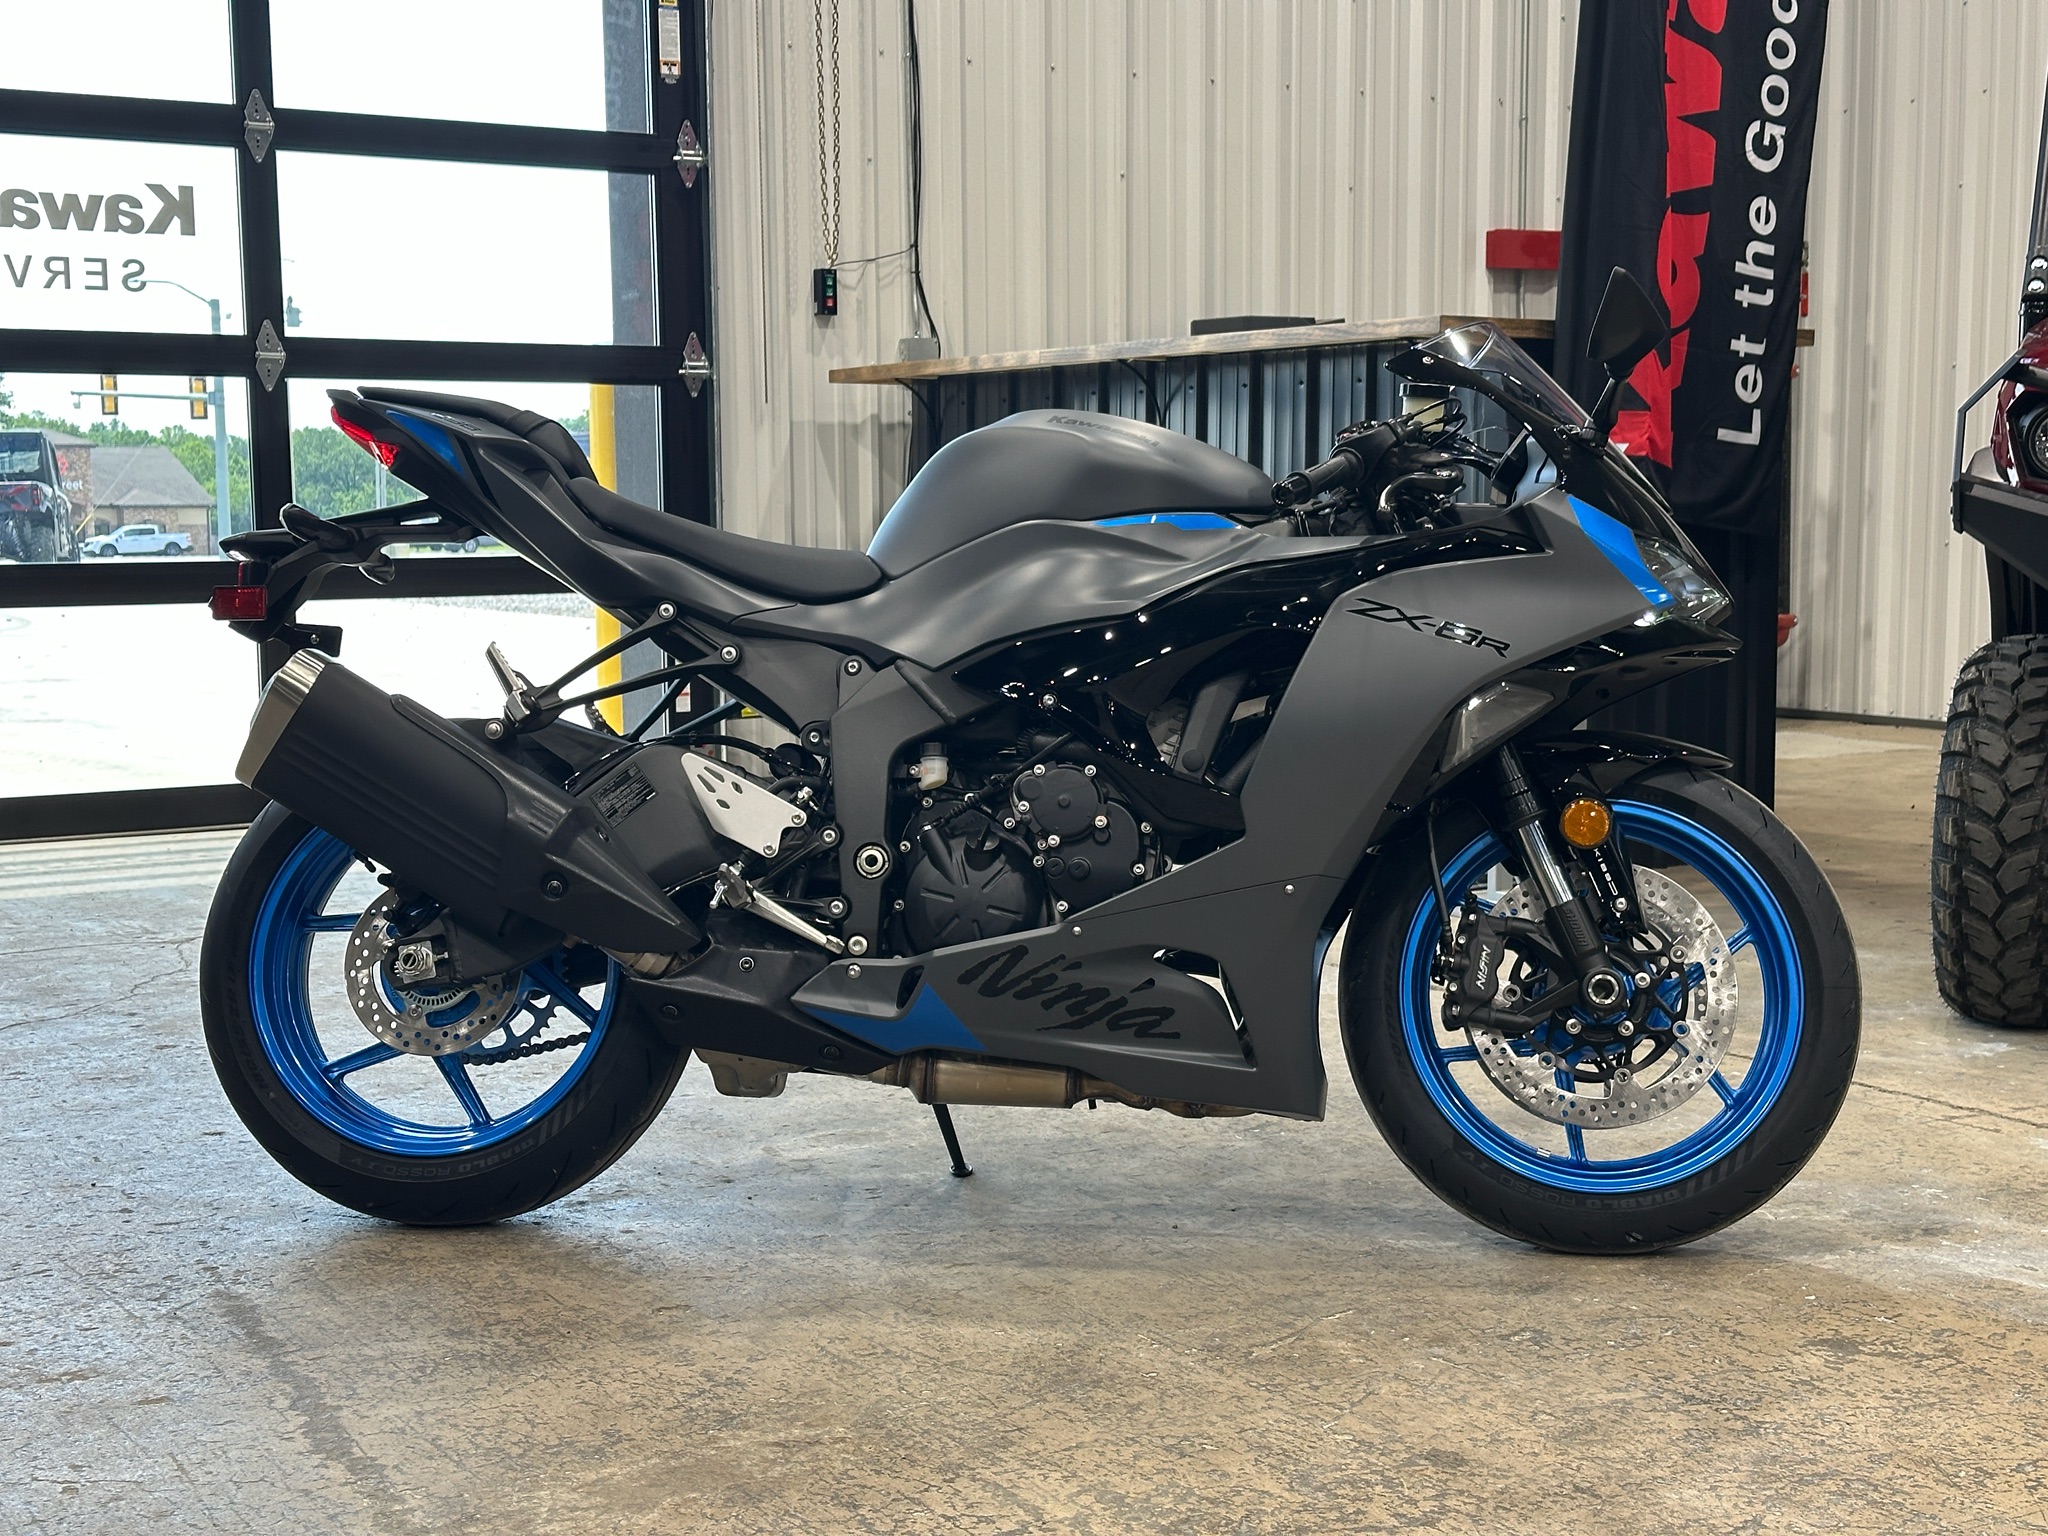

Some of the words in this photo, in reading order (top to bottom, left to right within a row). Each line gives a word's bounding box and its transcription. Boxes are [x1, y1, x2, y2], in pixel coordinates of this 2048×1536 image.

[1606, 0, 1729, 468] Kaw
[1734, 195, 1778, 308] the
[1716, 334, 1767, 446] Let
[1345, 598, 1512, 659] ZX-6R
[1562, 906, 1589, 947] SHOWA
[956, 944, 1181, 1039] Ninja
[347, 1155, 378, 1170] IV
[384, 1164, 451, 1177] ROSSO
[457, 1140, 534, 1173] DIABLO
[1499, 1172, 1577, 1208] ROSSO
[1583, 1187, 1680, 1210] DIABLO
